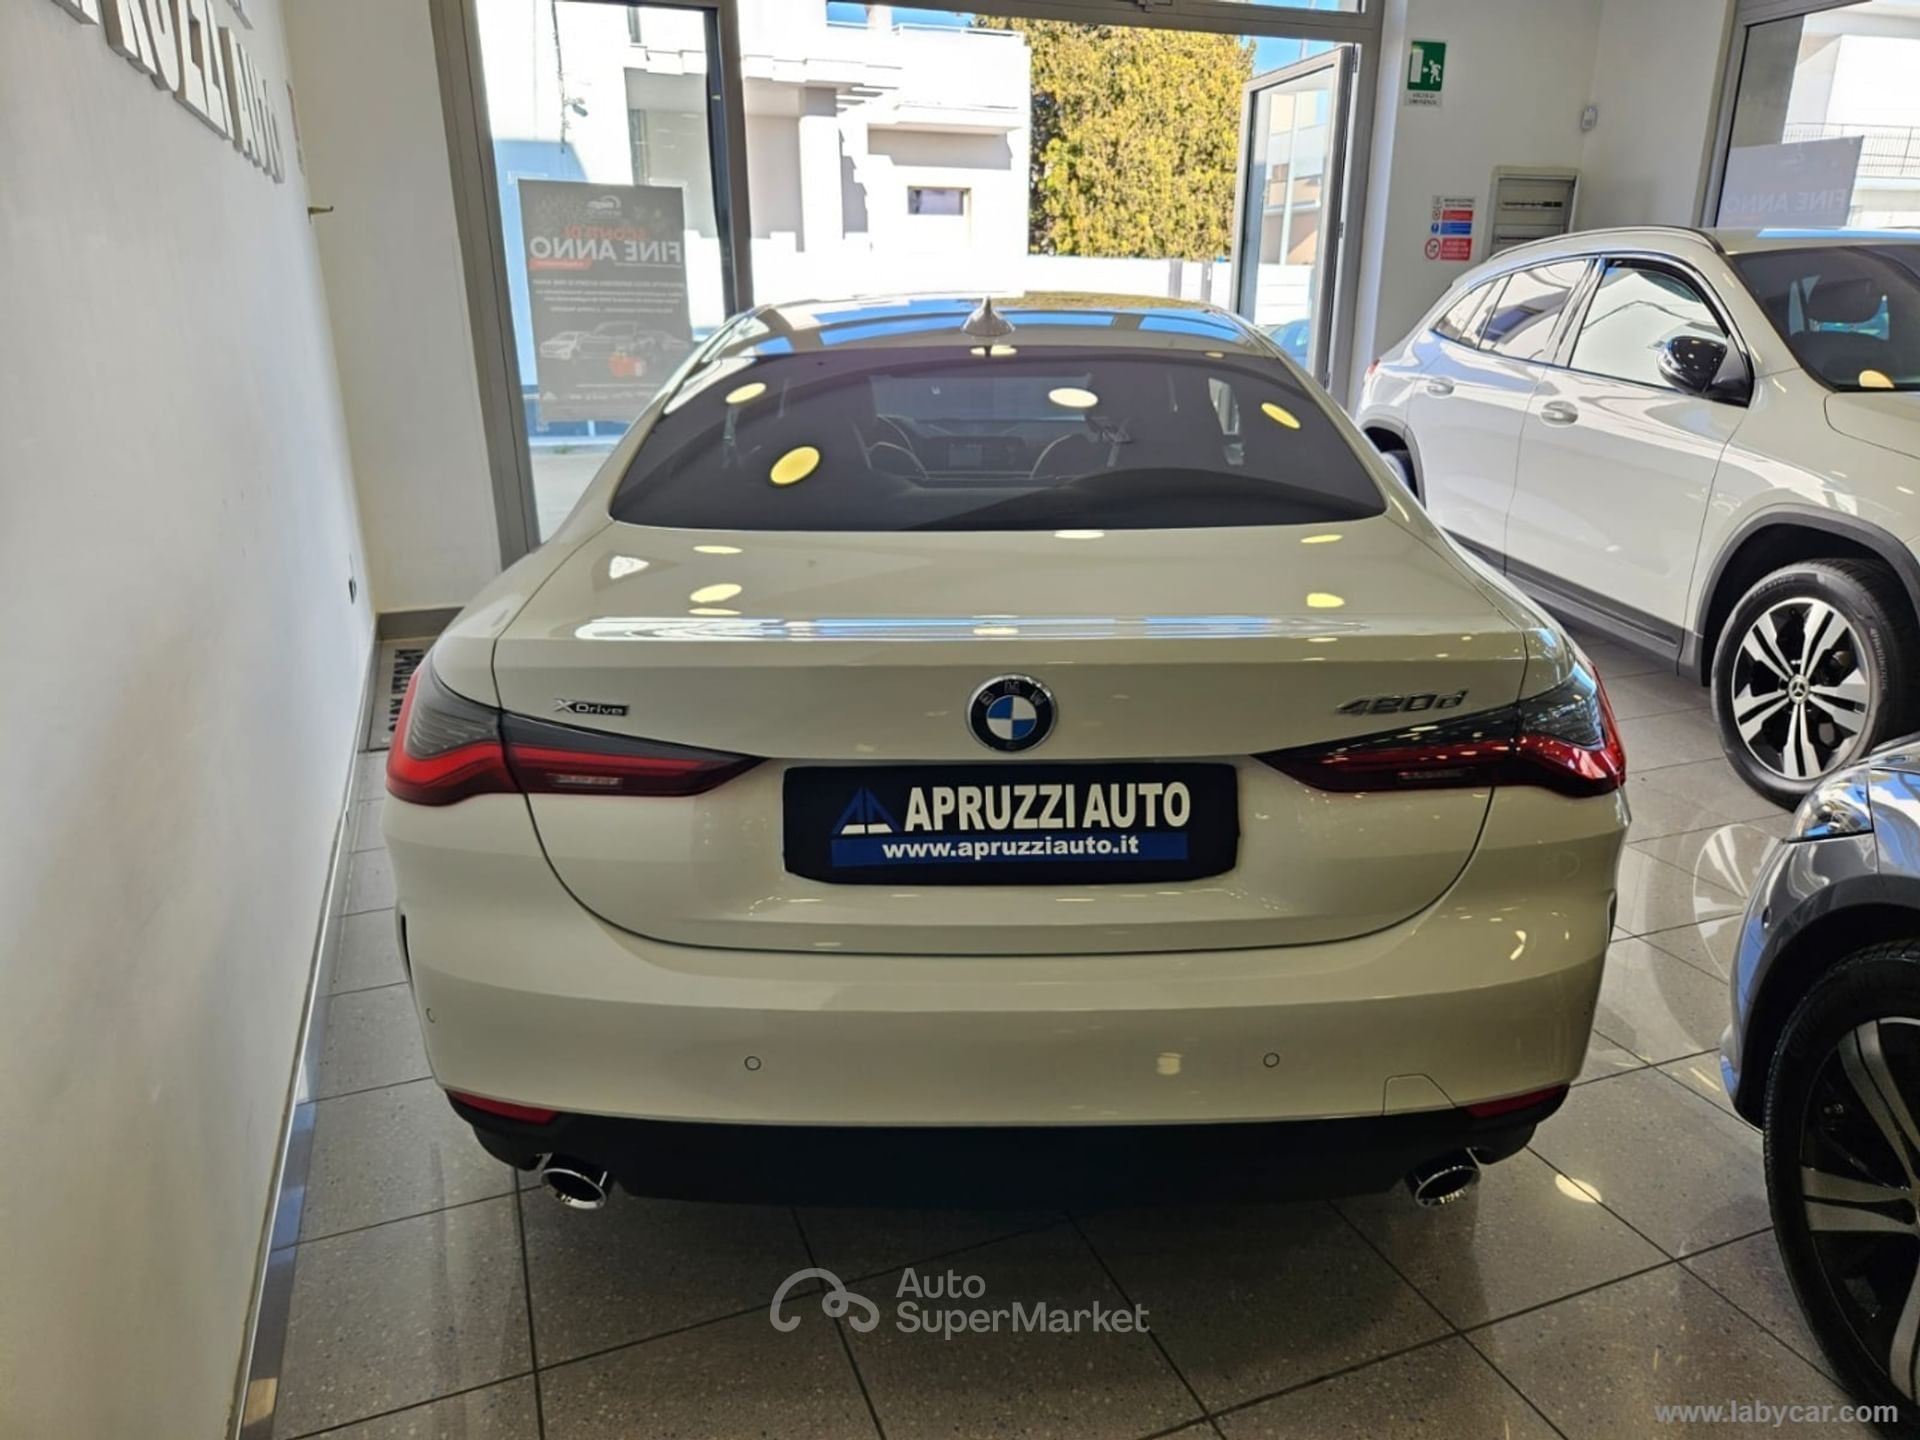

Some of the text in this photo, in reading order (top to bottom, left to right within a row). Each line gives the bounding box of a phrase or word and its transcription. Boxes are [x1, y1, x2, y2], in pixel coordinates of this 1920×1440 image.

[979, 680, 1047, 706] BMW
[1335, 689, 1469, 716] 420d
[904, 781, 1191, 832] APRUZZI AUTO
[882, 835, 1139, 861] www.apruzziauto.it
